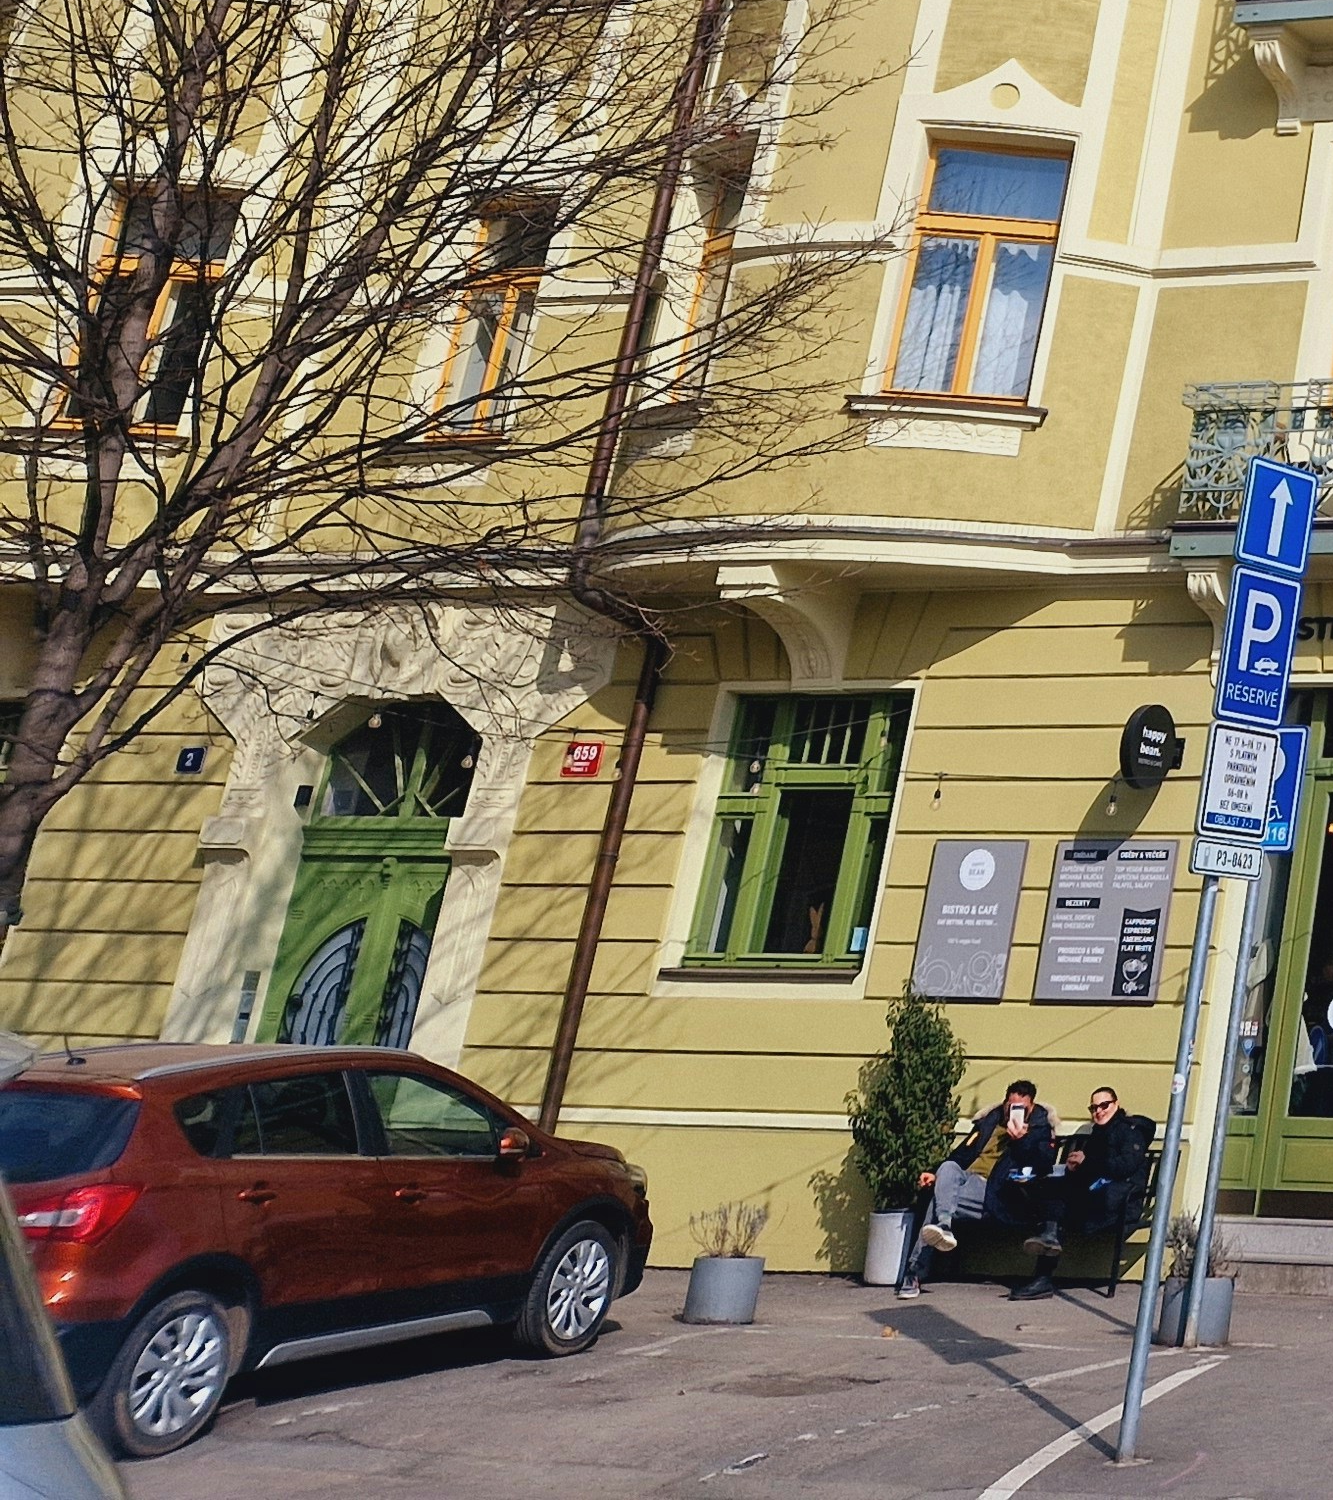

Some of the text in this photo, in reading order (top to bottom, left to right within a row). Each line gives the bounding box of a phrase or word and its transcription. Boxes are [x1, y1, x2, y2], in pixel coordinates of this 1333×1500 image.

[1238, 589, 1282, 671] P
[1226, 681, 1279, 708] RÉSERVÉ
[1142, 726, 1168, 744] happy
[185, 752, 194, 766] 2
[573, 745, 598, 760] 659
[1214, 814, 1240, 827] OBLAST
[1216, 849, 1253, 869] P3-0423
[942, 904, 970, 915] BISTRO
[978, 902, 999, 915] CAFÉ
